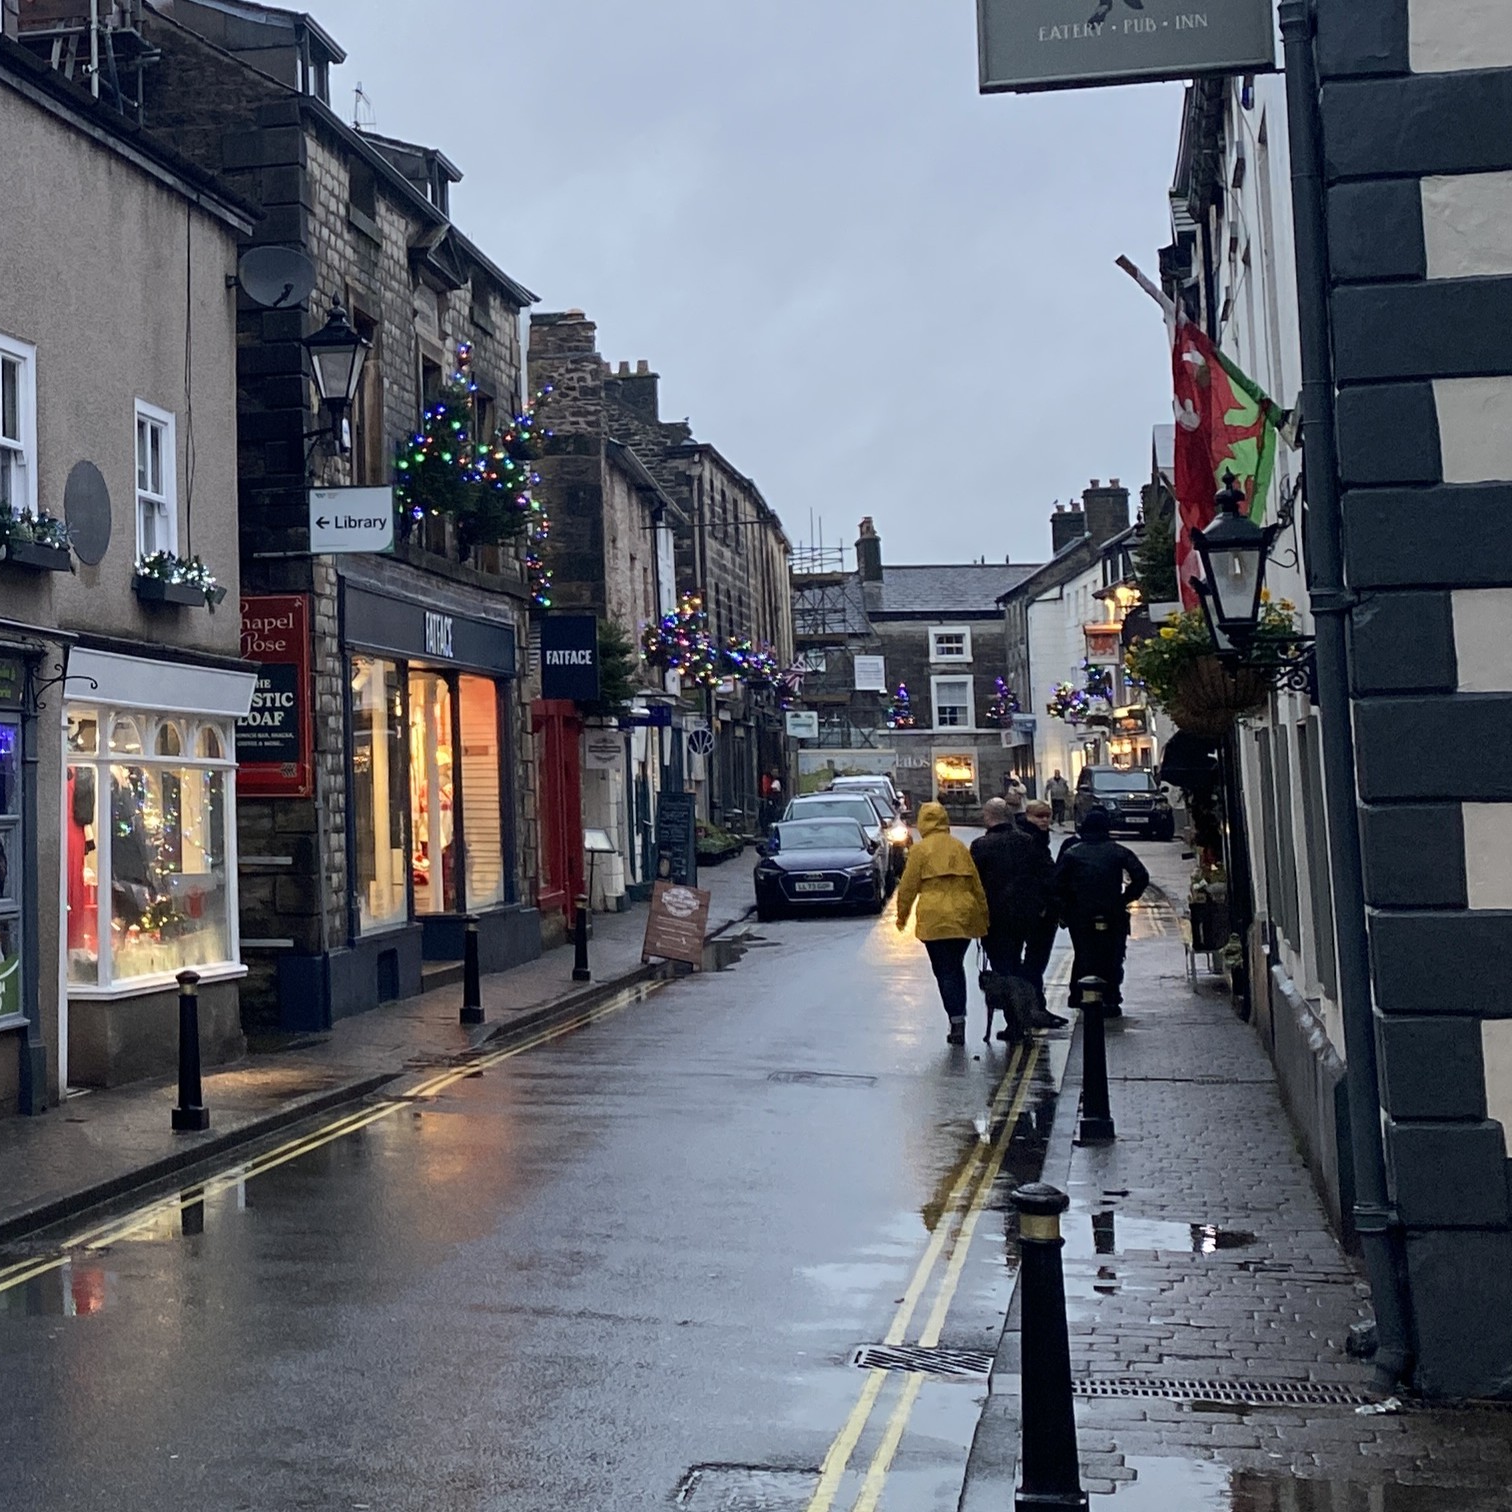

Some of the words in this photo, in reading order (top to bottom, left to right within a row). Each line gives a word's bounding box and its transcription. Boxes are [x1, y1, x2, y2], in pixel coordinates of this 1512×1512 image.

[1039, 21, 1105, 41] EATERY
[1123, 18, 1157, 34] PUB
[1175, 14, 1208, 29] INN
[334, 515, 387, 531] Library
[240, 602, 294, 634] hapel
[425, 610, 454, 658] FATFACE
[546, 649, 593, 665] FATFACE
[256, 679, 270, 688] HE
[251, 692, 294, 708] STIC
[237, 711, 284, 726] LOAF
